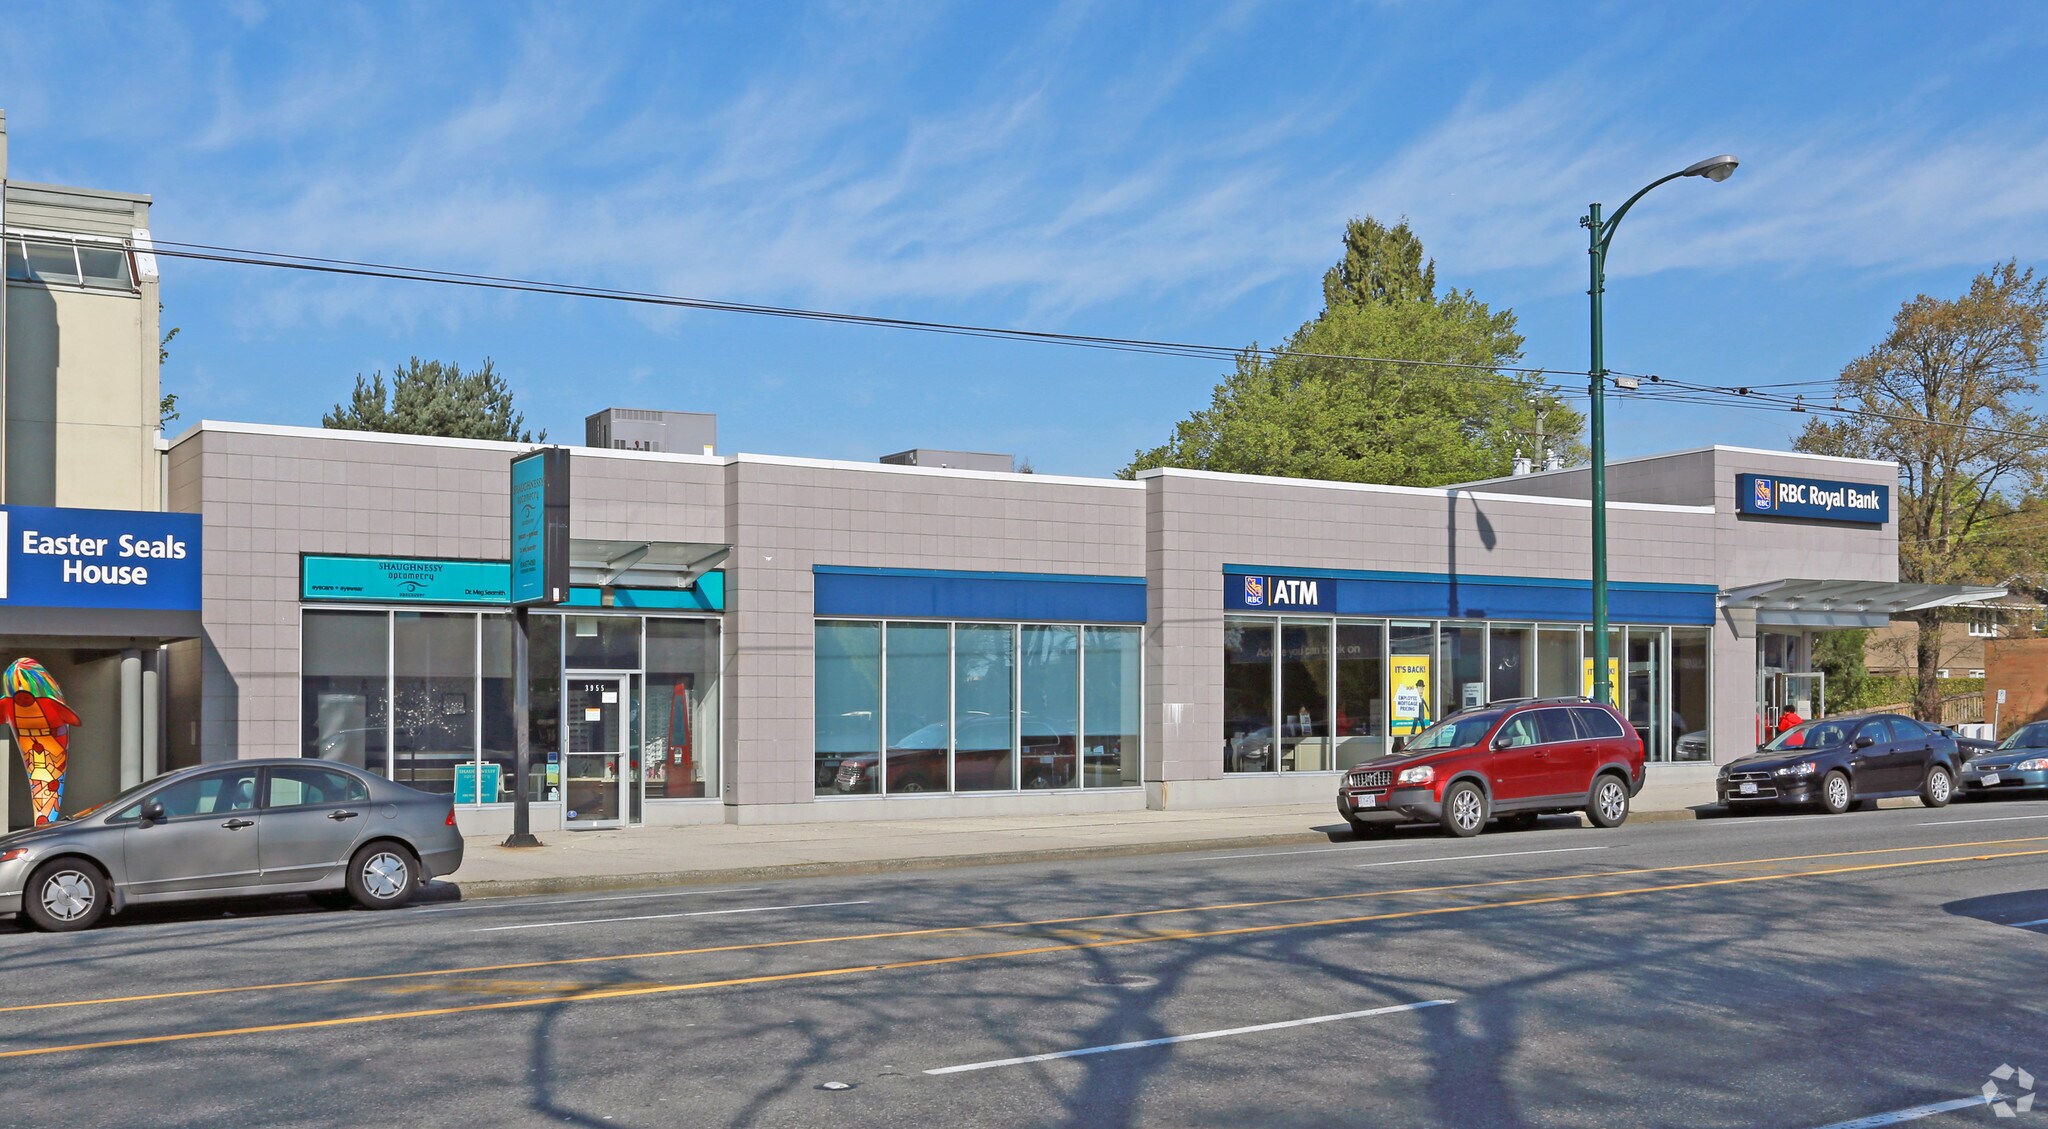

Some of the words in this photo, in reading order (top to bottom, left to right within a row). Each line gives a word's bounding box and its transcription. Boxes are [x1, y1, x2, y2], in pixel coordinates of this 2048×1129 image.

[1757, 499, 1769, 507] RBC
[1779, 483, 1806, 504] RBC
[1809, 486, 1845, 511] Royal
[1847, 489, 1880, 510] Bank
[22, 530, 108, 556] Easter
[118, 534, 187, 559] Seals
[63, 559, 148, 585] House
[378, 562, 443, 572] SHAUGHNESSY
[388, 572, 434, 581] optometry
[1247, 596, 1262, 604] RBC
[1273, 579, 1318, 606] ATM
